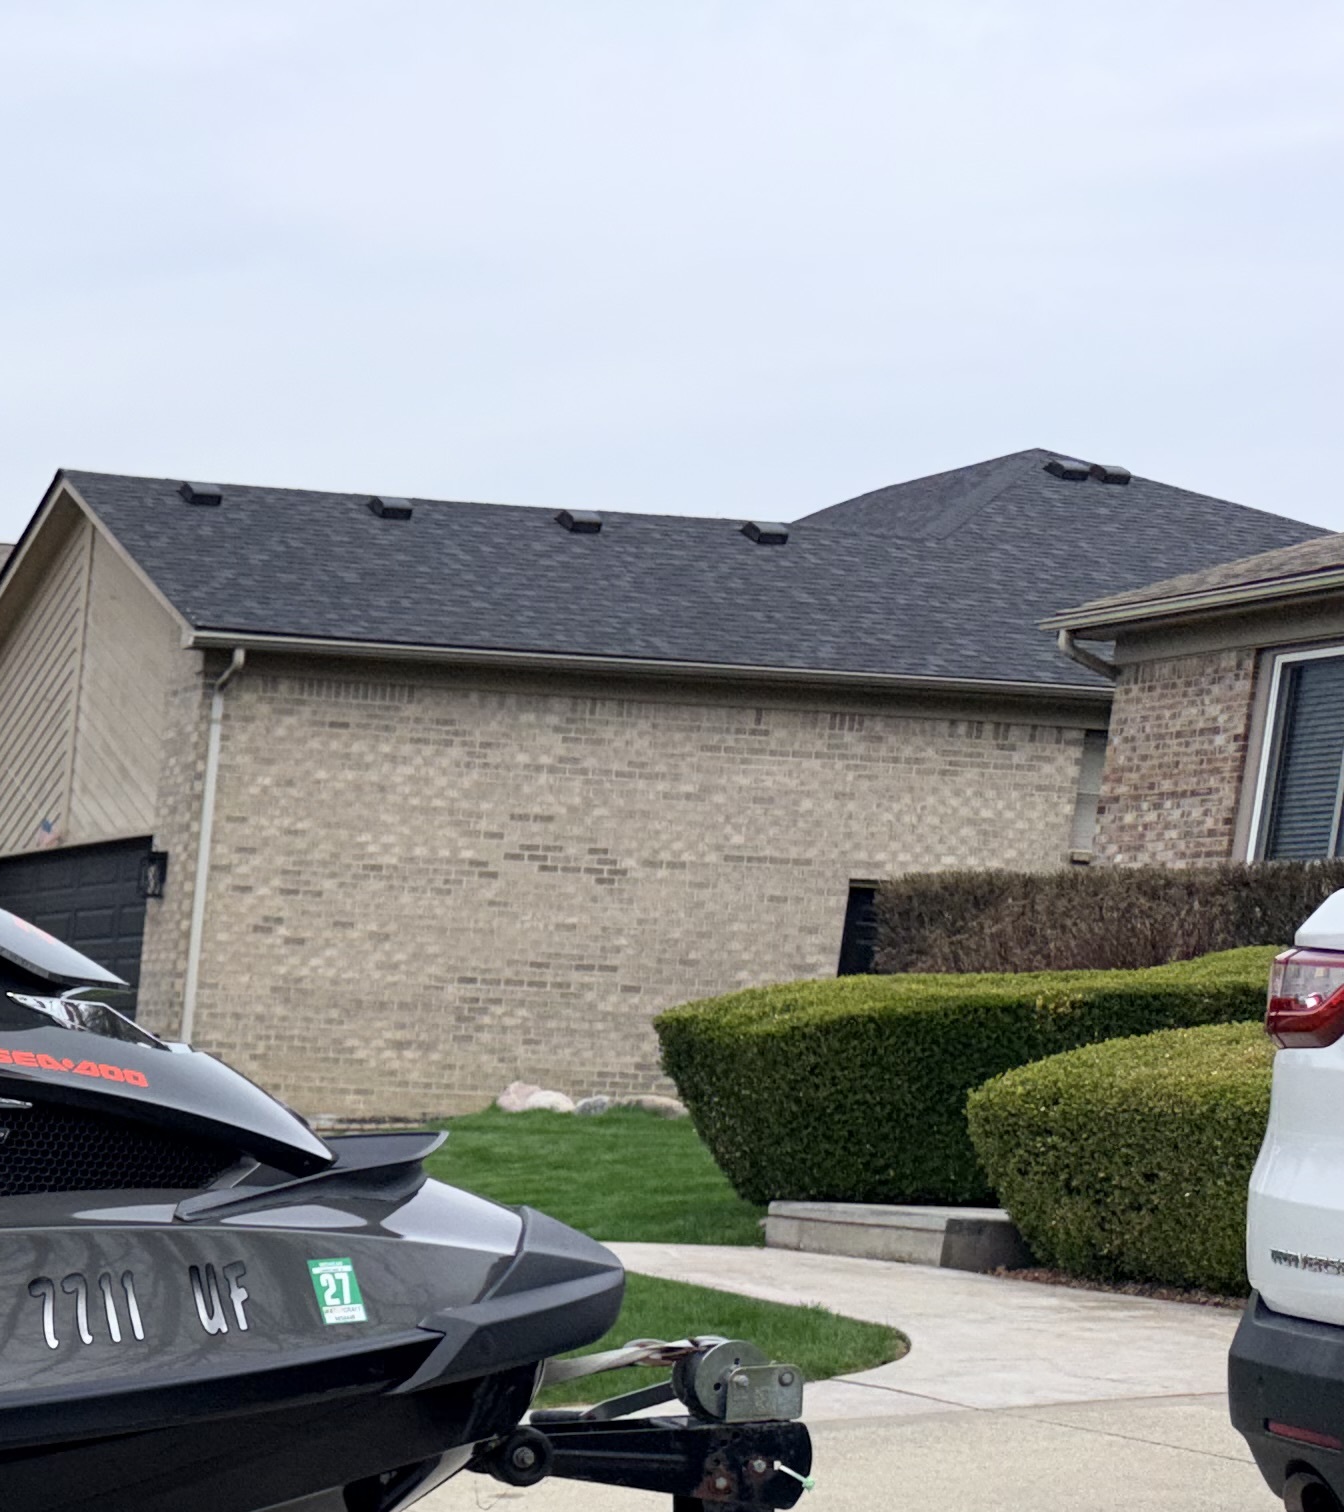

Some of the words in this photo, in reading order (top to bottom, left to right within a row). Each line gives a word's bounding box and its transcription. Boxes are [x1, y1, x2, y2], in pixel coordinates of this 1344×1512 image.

[27, 1269, 145, 1350] 7711
[188, 1260, 249, 1335] UF
[319, 1271, 352, 1306] 27
